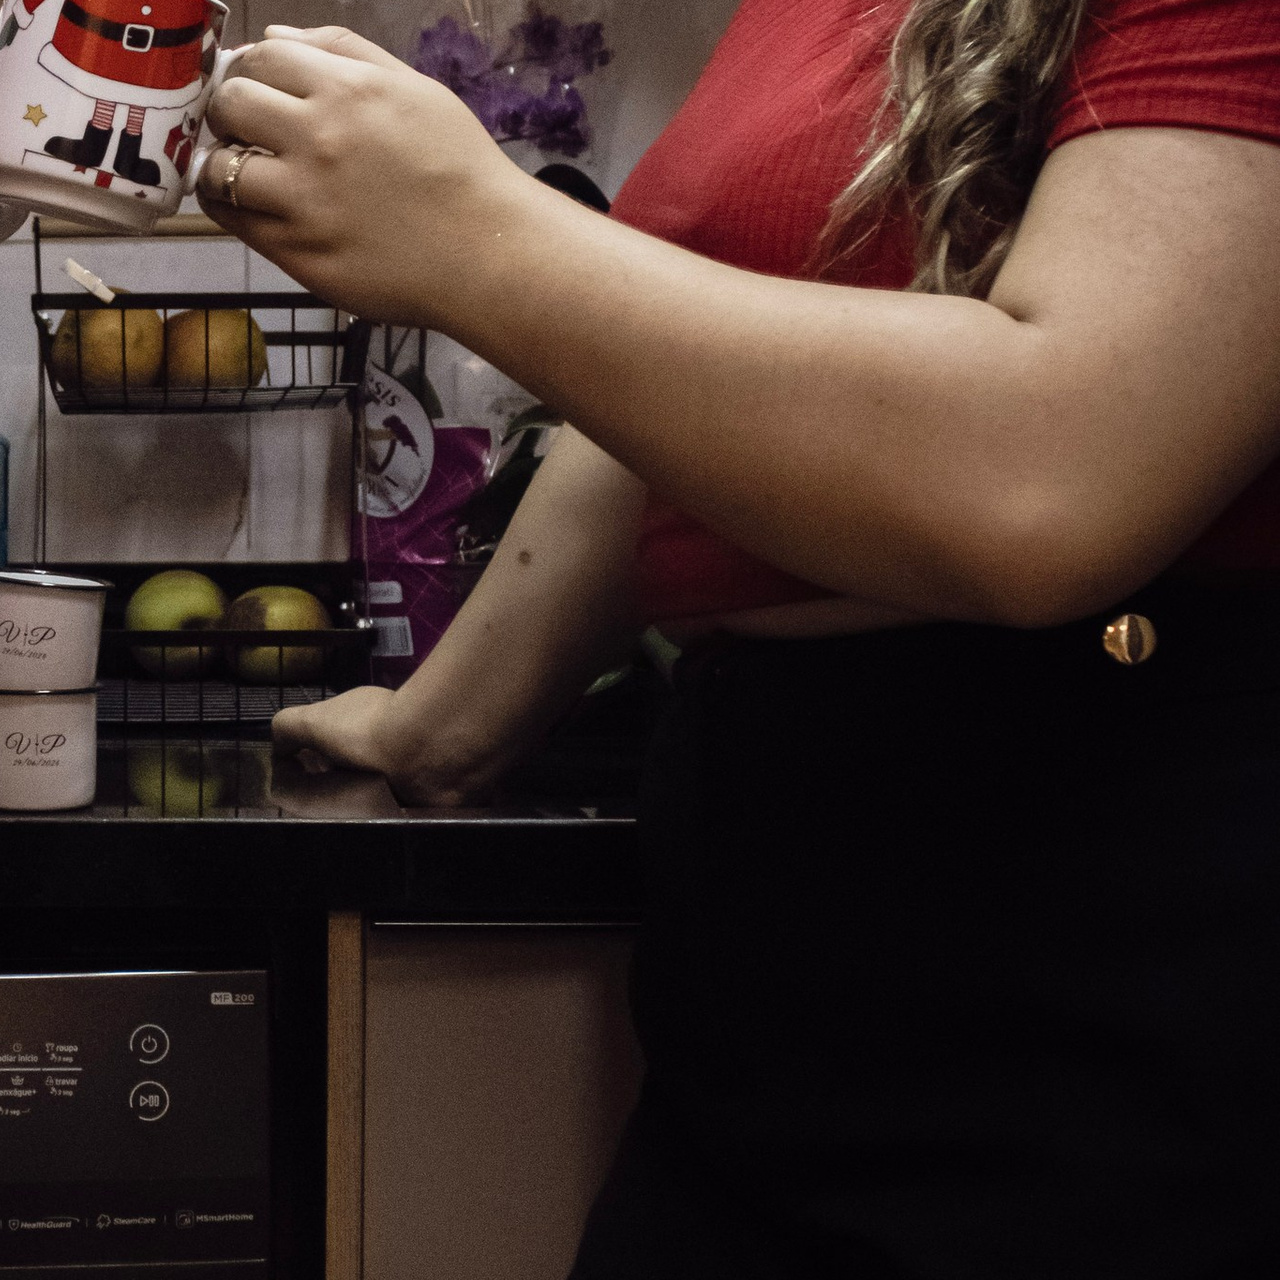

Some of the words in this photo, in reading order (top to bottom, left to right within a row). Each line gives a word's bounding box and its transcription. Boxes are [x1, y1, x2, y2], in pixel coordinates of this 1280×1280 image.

[56, 1045, 79, 1053] roupa
[113, 1217, 156, 1225] SteamCare
[196, 1214, 254, 1222] MSmartHome
[20, 1220, 72, 1229] HealthGuard
